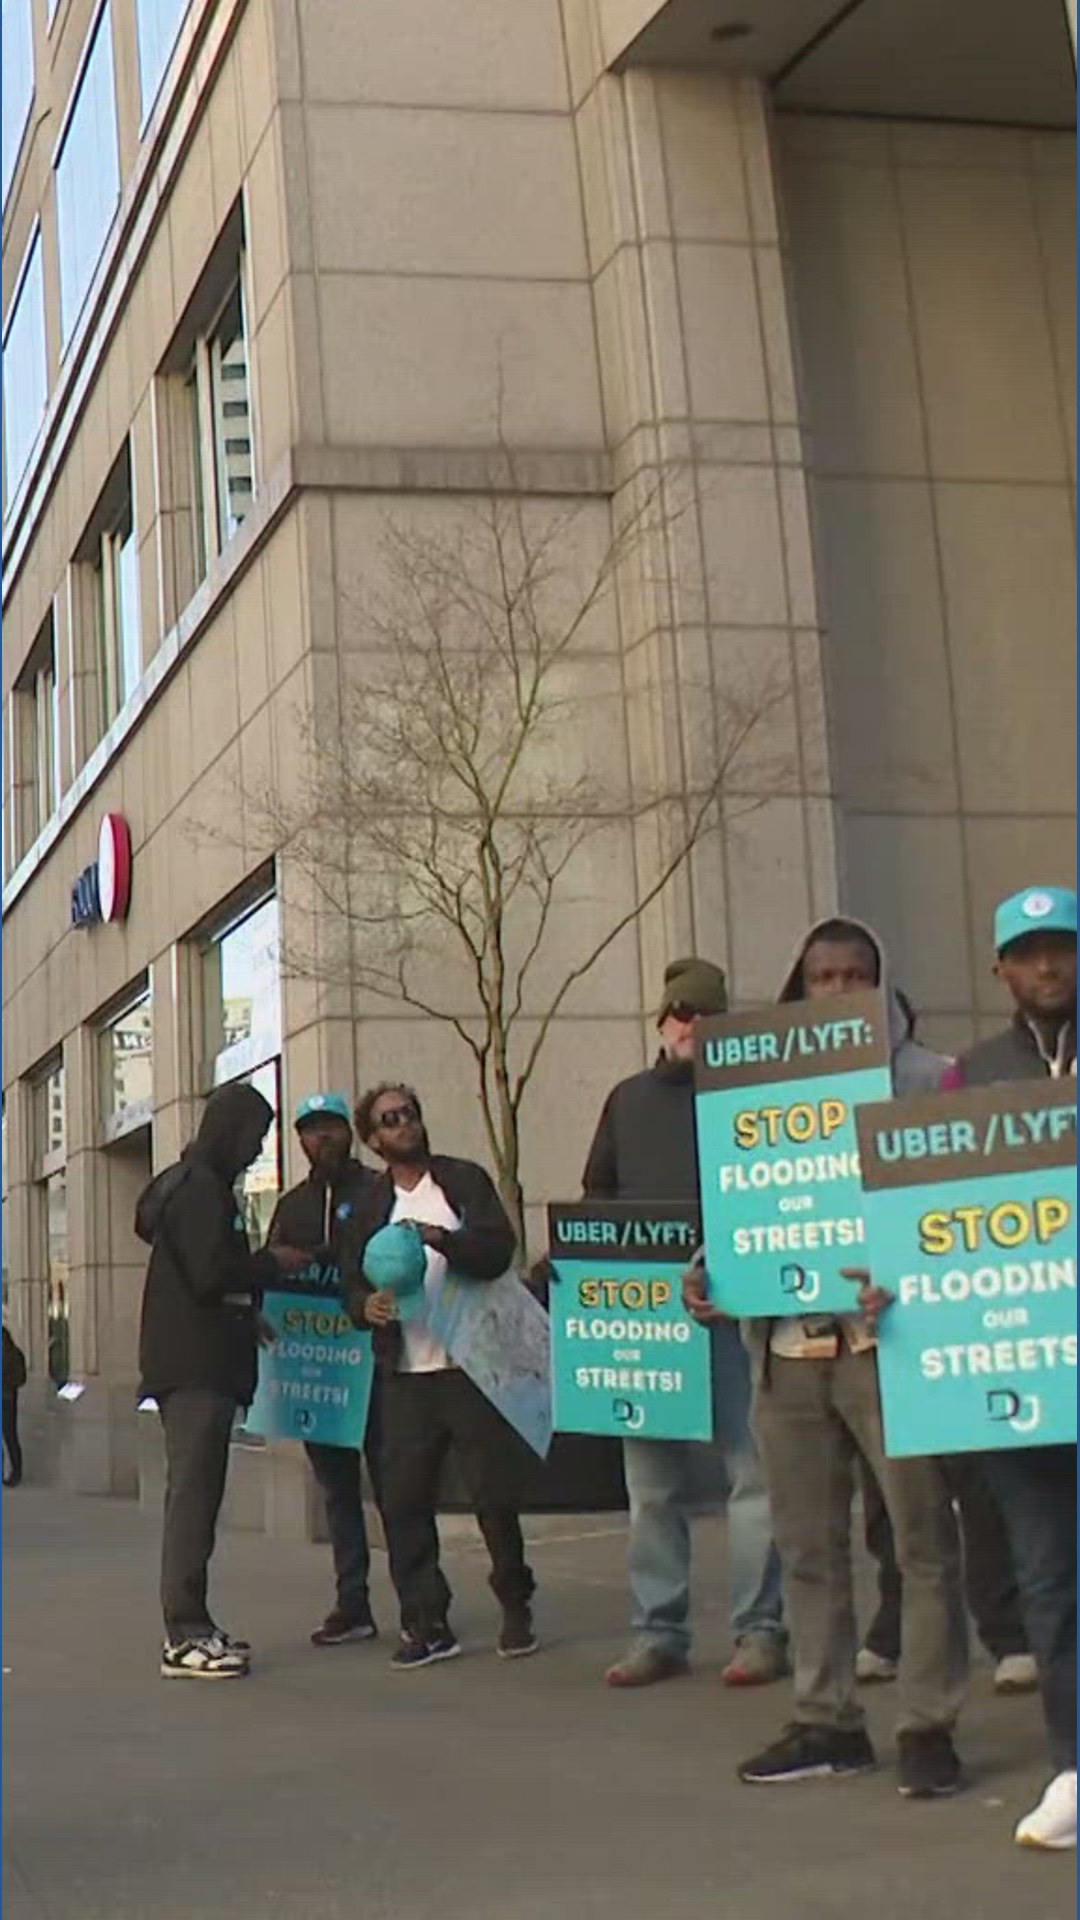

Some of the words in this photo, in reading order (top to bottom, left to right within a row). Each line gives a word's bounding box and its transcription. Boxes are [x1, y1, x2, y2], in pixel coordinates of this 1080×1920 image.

[706, 1018, 873, 1067] UBER/LYFT:
[735, 1098, 847, 1150] STOP
[876, 1105, 1077, 1162] UBER/LYF
[778, 1195, 814, 1213] OUR
[557, 1220, 697, 1246] UBER/LYFT:
[733, 1216, 865, 1256] STREETS!
[918, 1198, 1070, 1256] STOP
[580, 1279, 671, 1310] STOP
[284, 1308, 353, 1338] STOP
[565, 1316, 691, 1343] FLOODING
[982, 1306, 1030, 1329] OUR
[612, 1348, 642, 1362] OUR
[575, 1366, 683, 1392] STREETS!
